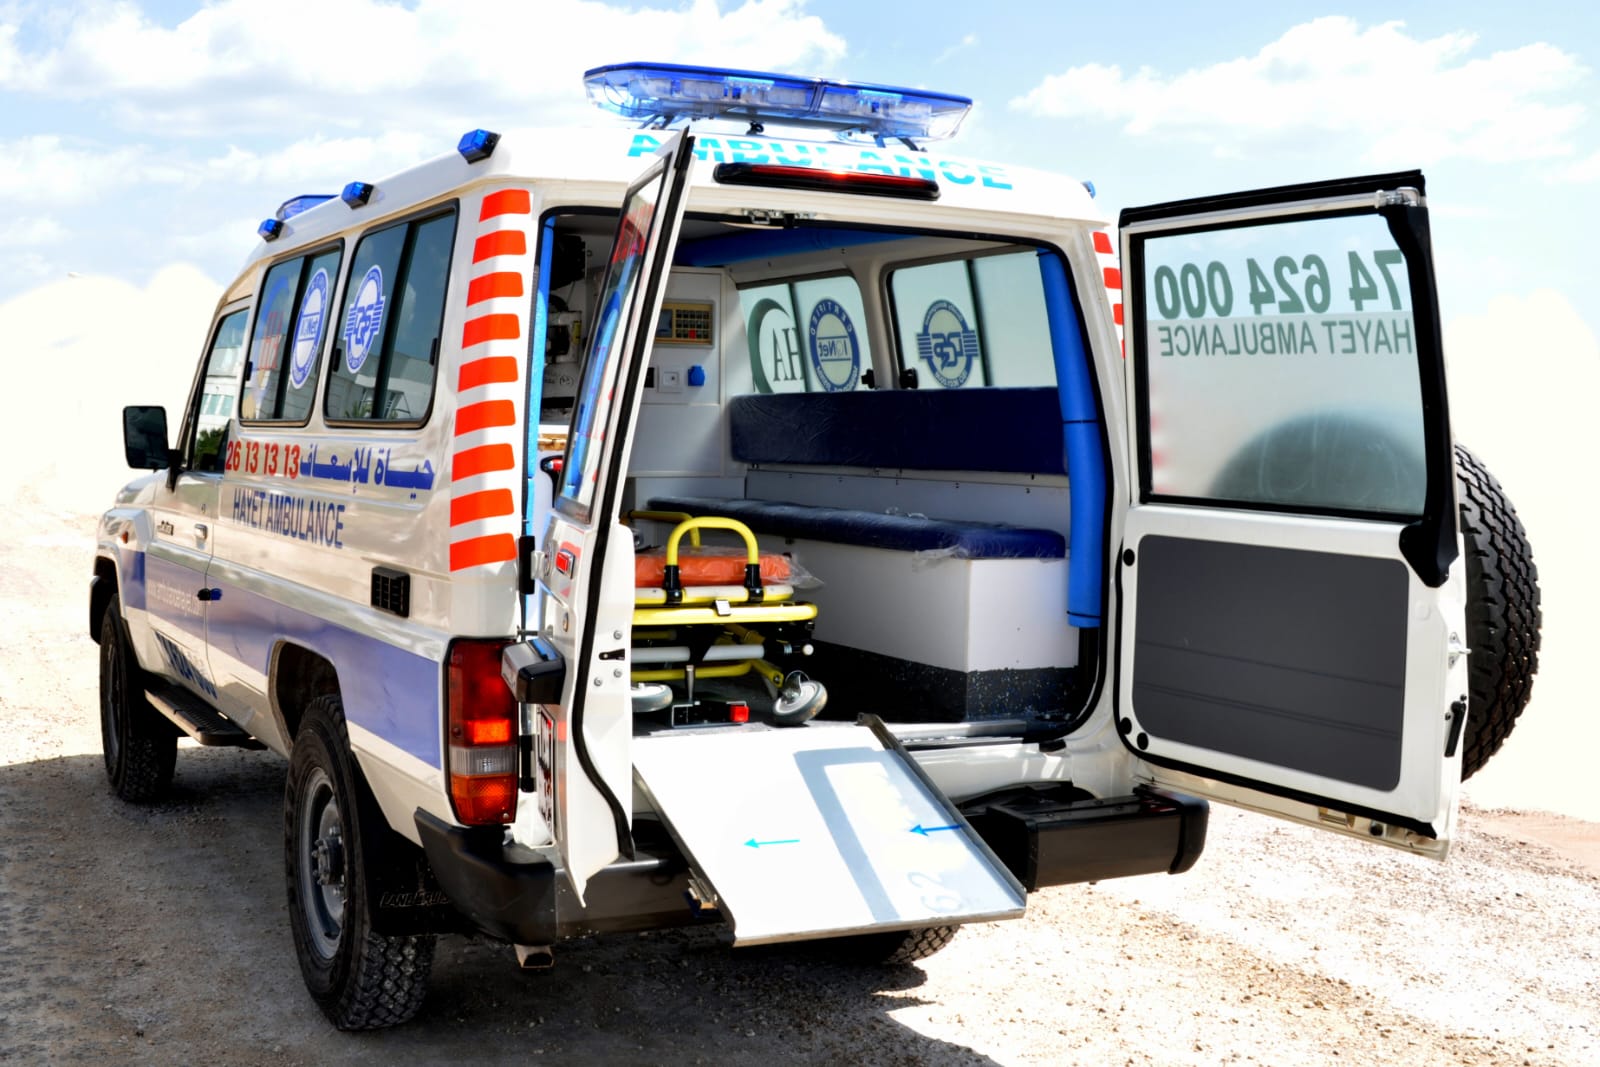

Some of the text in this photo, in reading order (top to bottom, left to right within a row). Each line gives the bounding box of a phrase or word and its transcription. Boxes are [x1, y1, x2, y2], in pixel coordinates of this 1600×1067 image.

[627, 133, 1014, 190] AMBULANCE
[225, 440, 301, 480] 26 13 13 13
[233, 487, 345, 549] HAYET AMBULANCE
